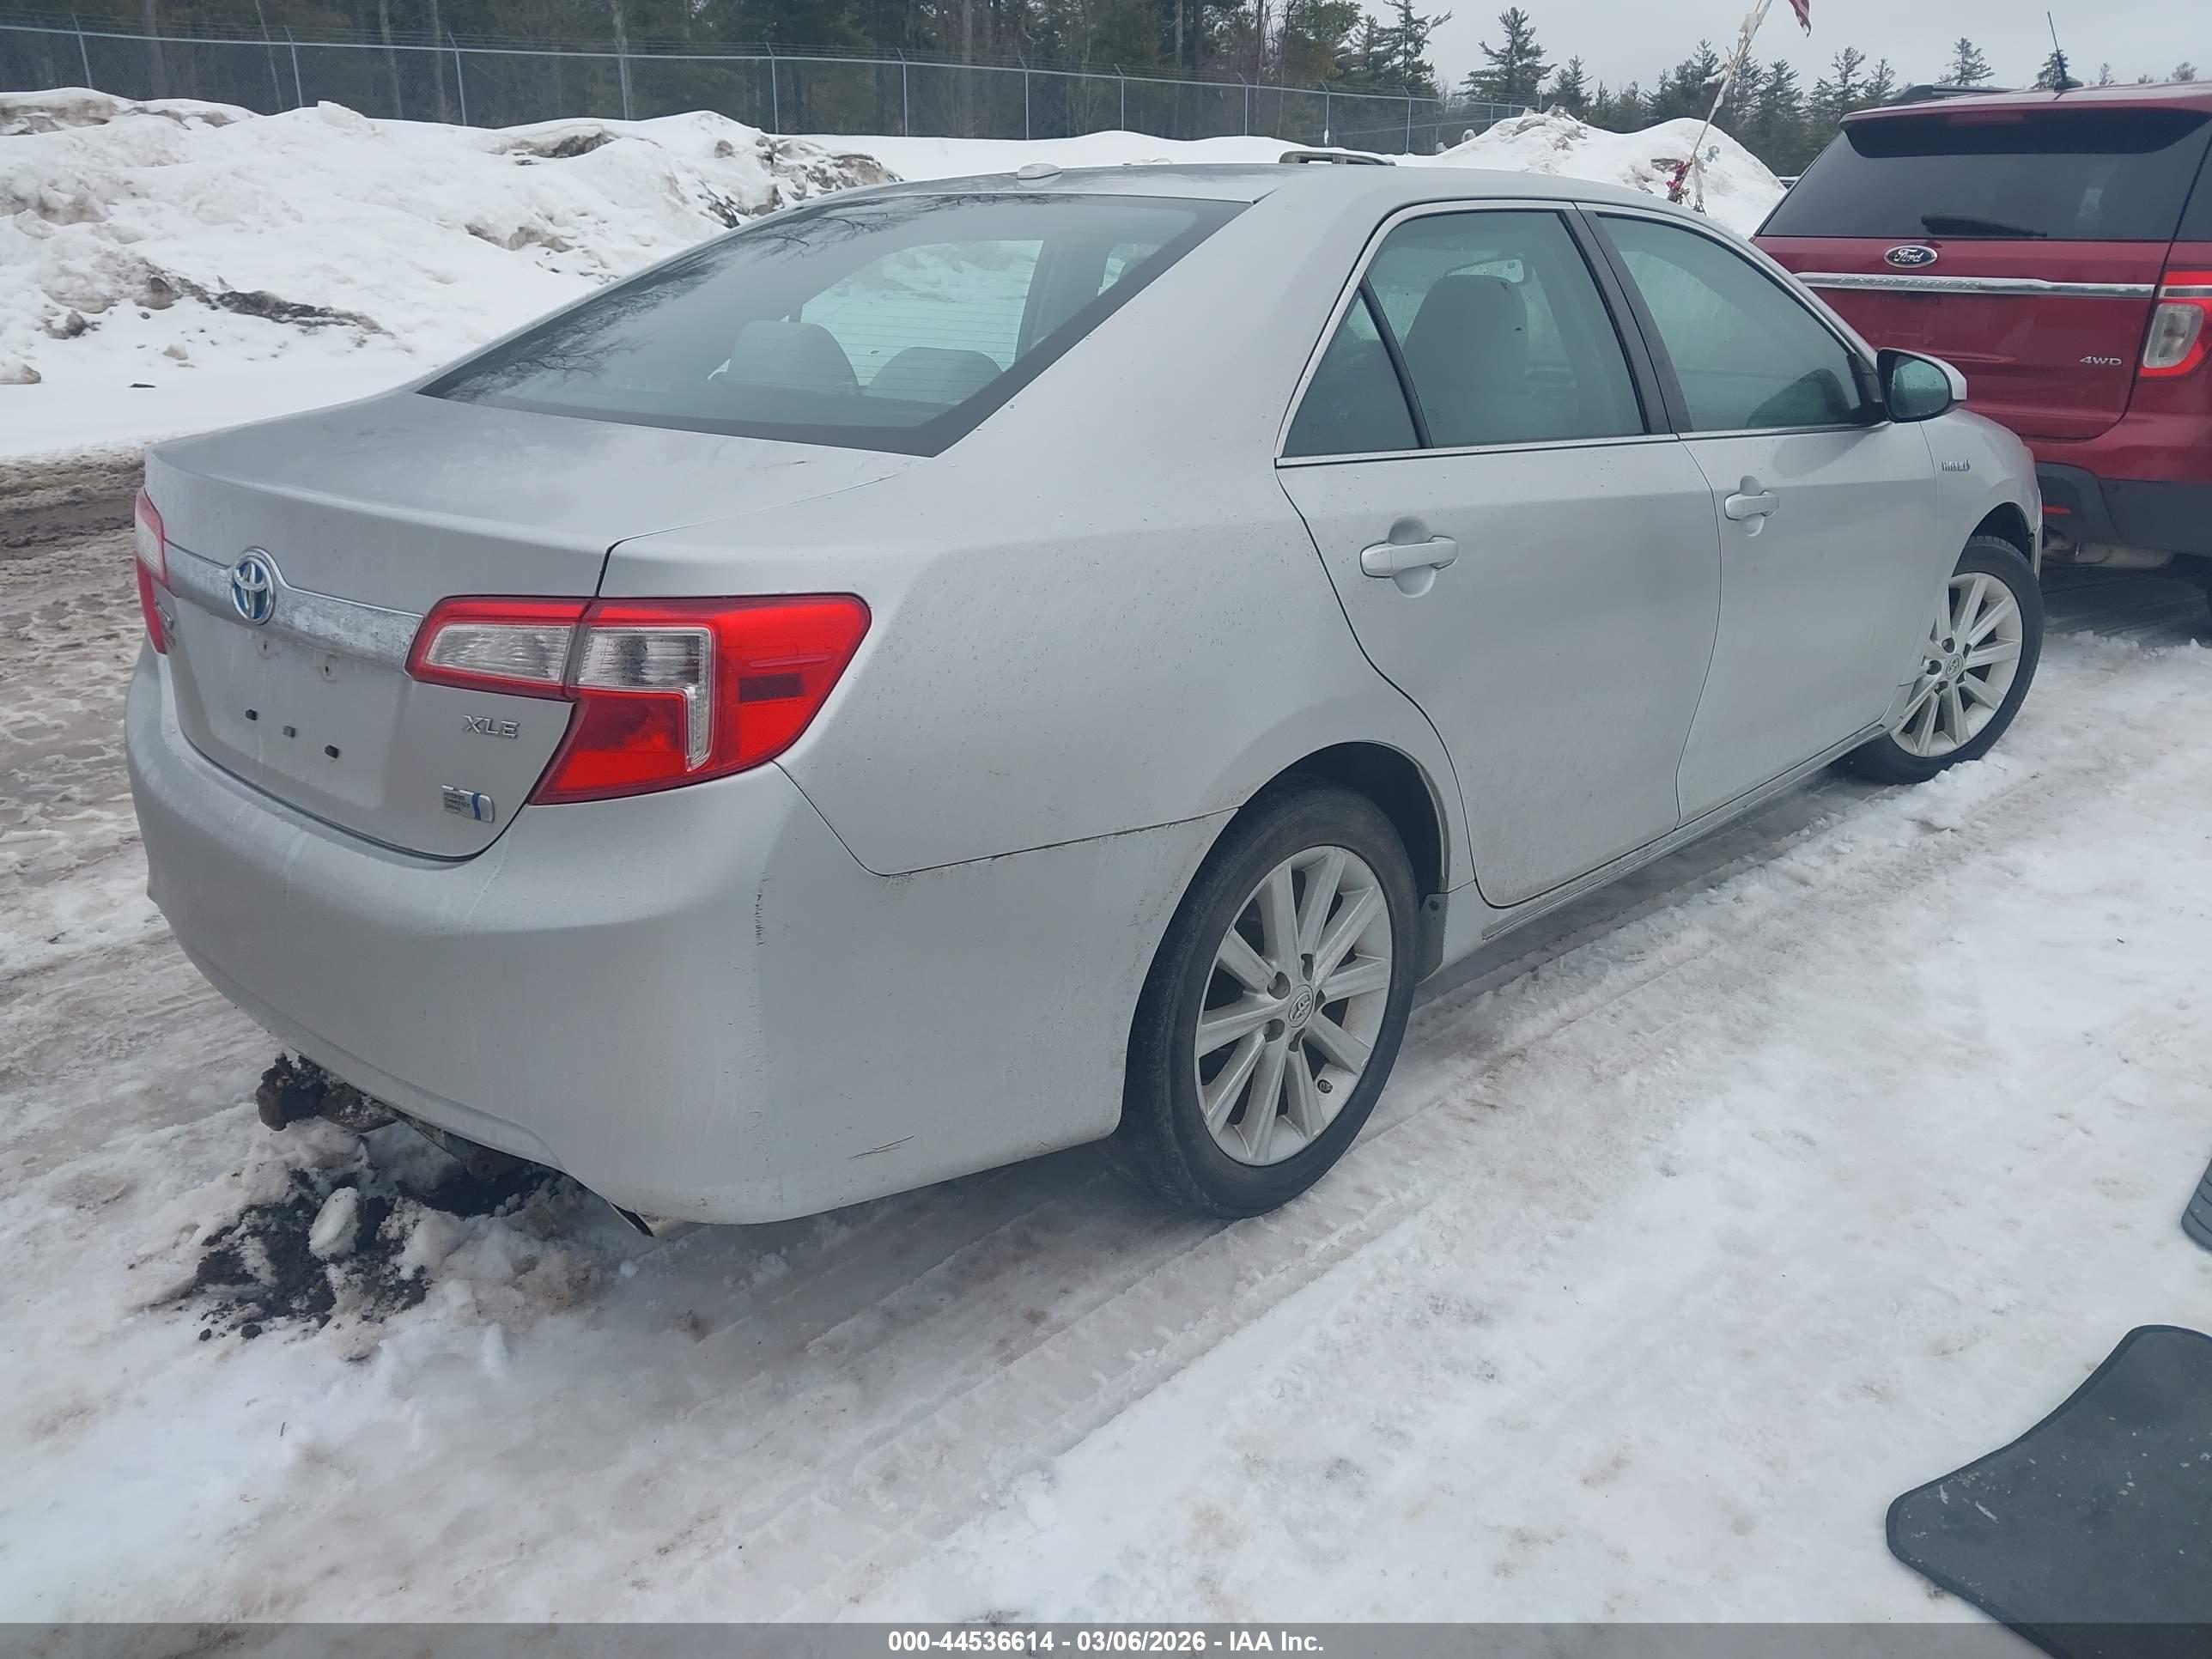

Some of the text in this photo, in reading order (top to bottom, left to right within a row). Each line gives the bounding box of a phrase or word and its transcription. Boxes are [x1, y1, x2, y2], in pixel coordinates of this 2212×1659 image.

[1893, 247, 1923, 263] Ford
[1838, 276, 1982, 290] EXPLORER
[2079, 356, 2123, 366] 4WD
[462, 714, 520, 738] XLE
